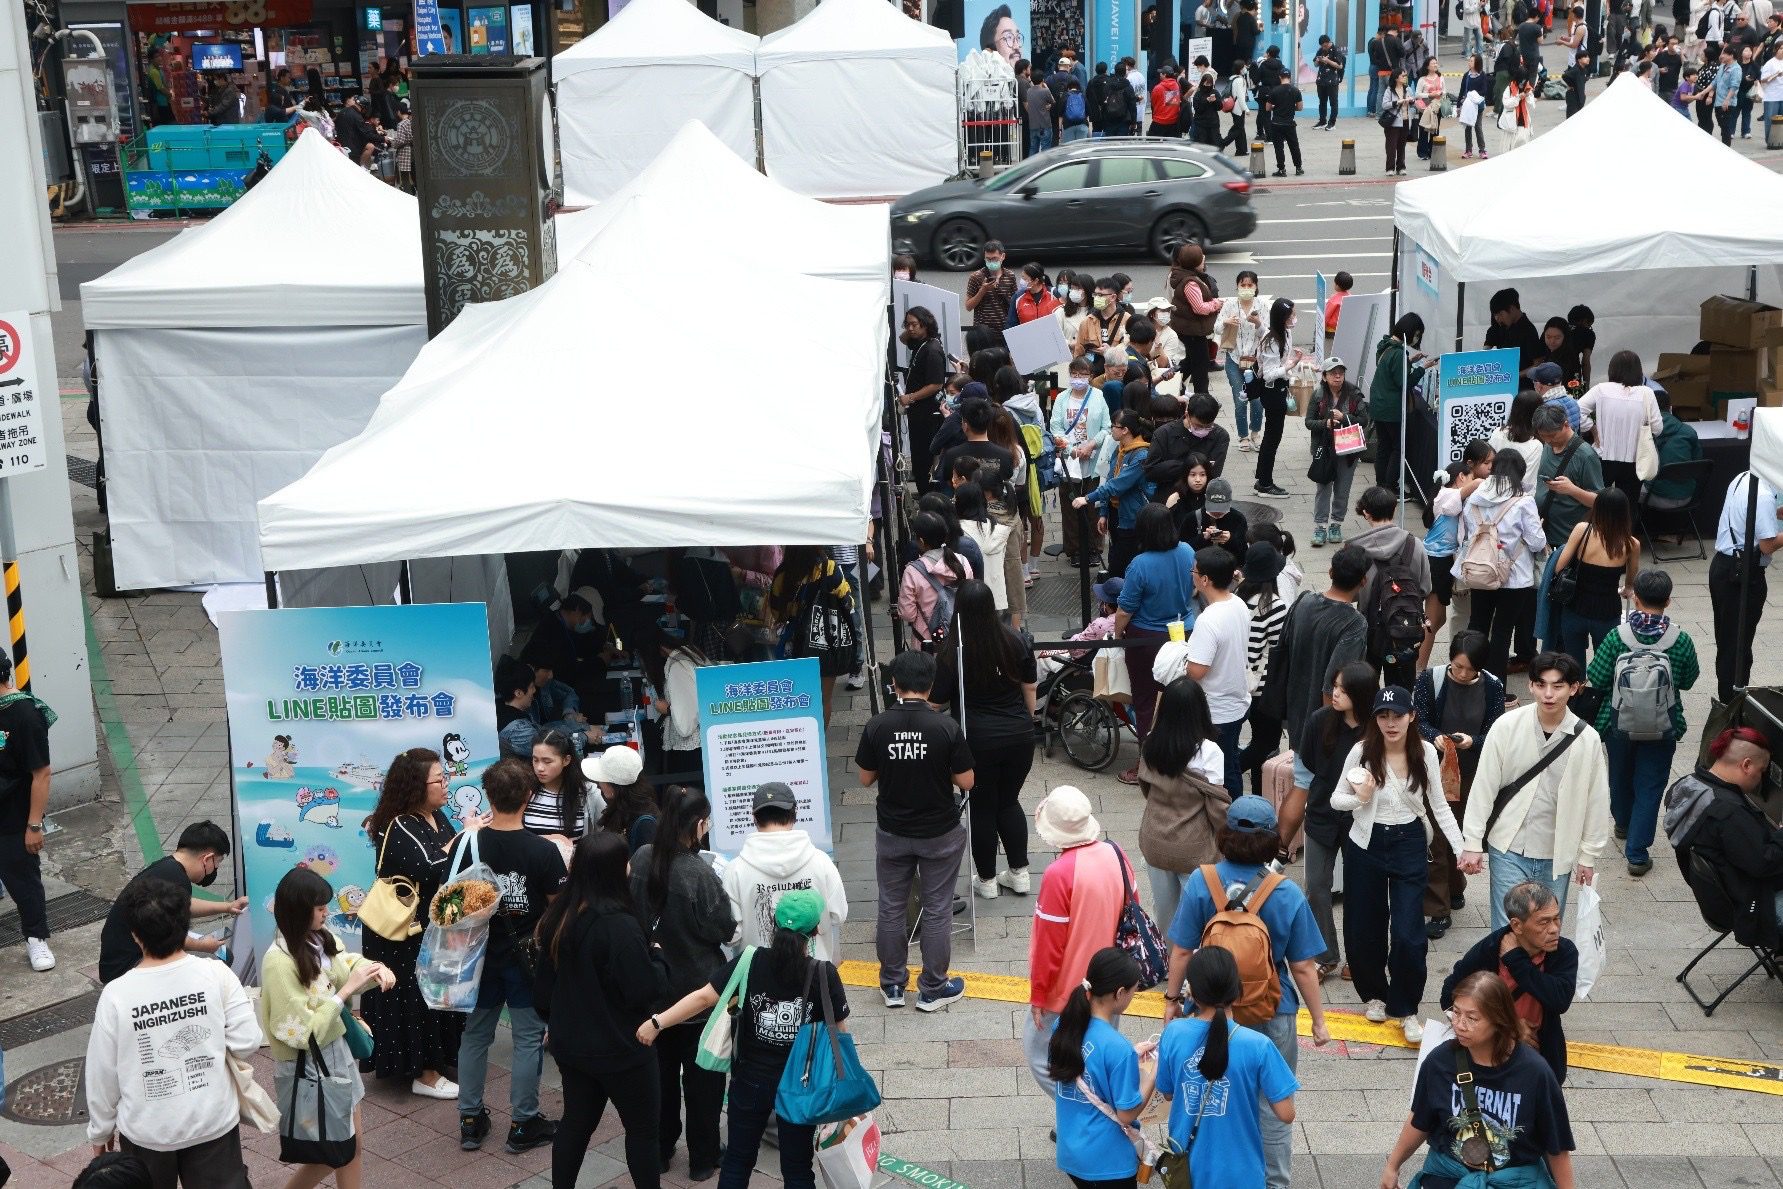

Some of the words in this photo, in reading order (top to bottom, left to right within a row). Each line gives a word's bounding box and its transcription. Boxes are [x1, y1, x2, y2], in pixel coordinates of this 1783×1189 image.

[368, 10, 380, 28] 藥
[19, 437, 36, 446] ZONE
[11, 455, 28, 466] 110
[294, 662, 422, 690] 海洋委員會
[725, 679, 794, 698] 海洋委員會
[267, 691, 455, 720] LINE貼圖發布會
[710, 693, 811, 715] LINE貼圖發布會
[894, 732, 922, 740] TAIYI
[888, 743, 927, 759] STAFF
[132, 992, 206, 1018] JAPANESE
[133, 1005, 208, 1031] NIGIRIZUSHI
[759, 1027, 798, 1040] M&Oce
[1452, 1083, 1521, 1128] CERNAT
